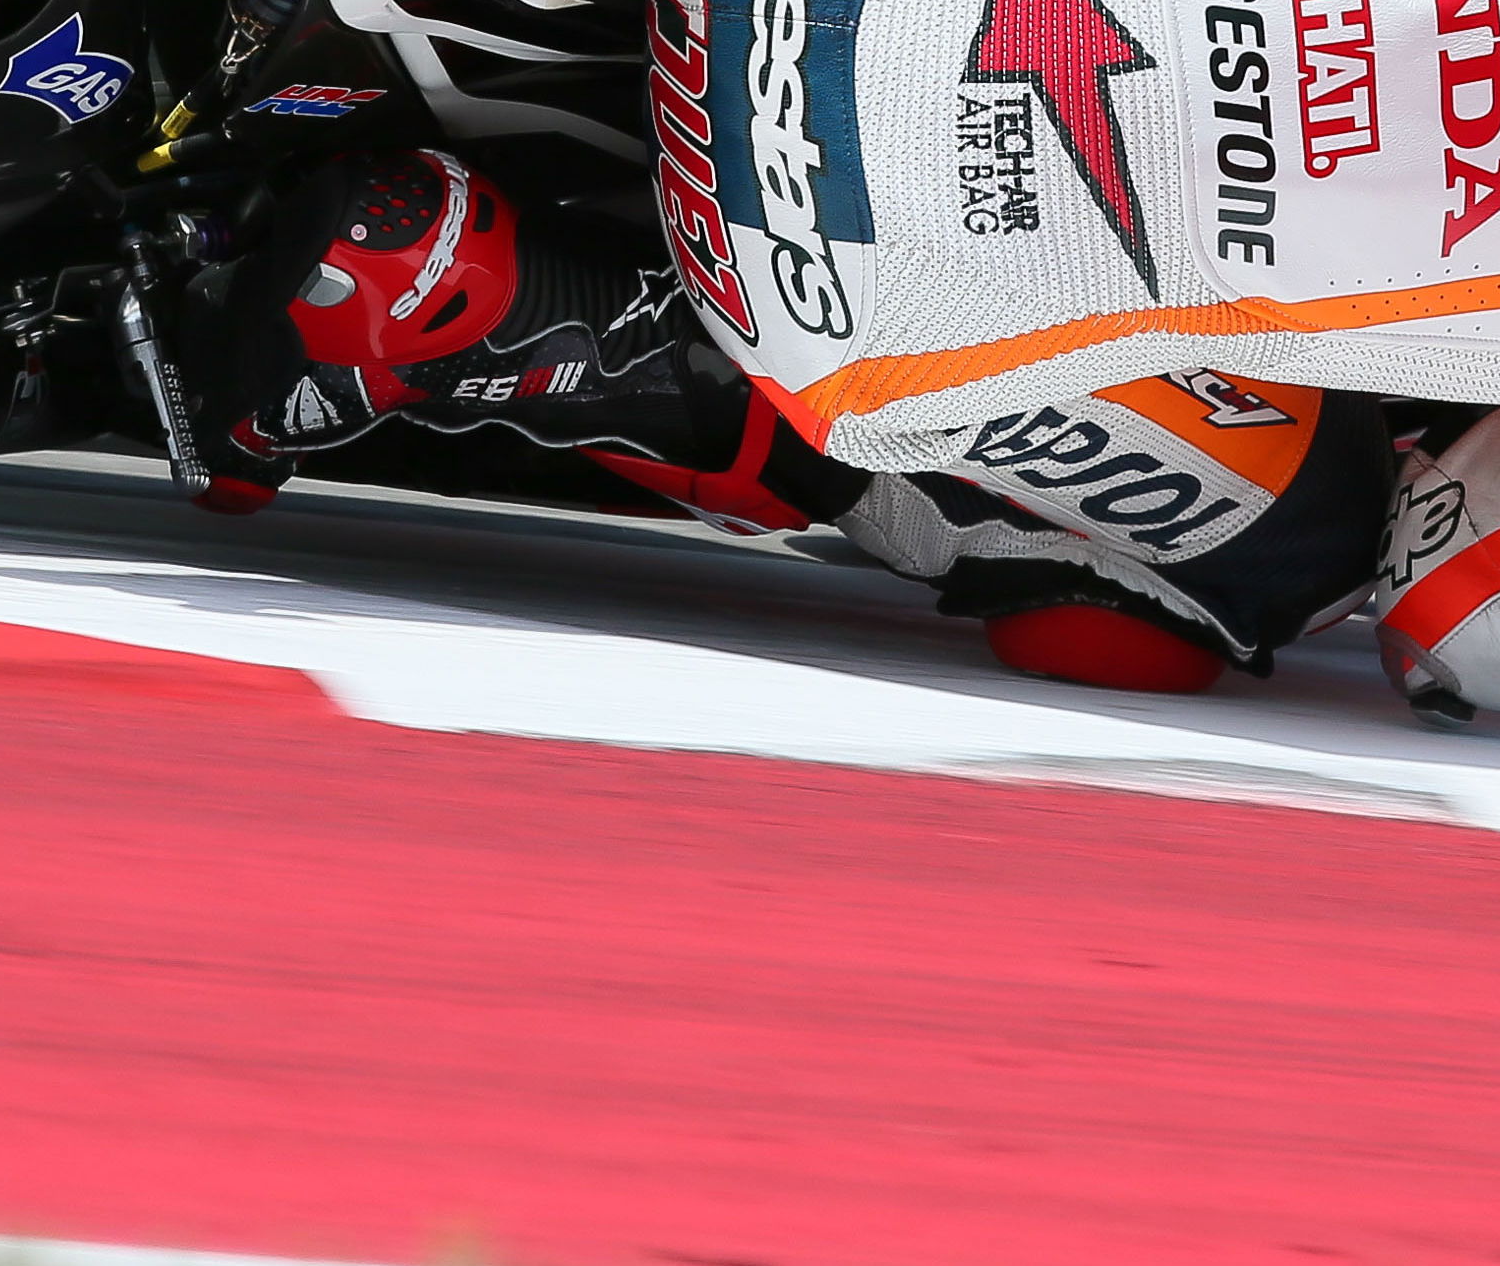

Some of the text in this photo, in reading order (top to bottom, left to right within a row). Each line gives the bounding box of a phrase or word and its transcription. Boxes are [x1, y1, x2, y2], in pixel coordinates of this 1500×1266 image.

[25, 59, 126, 114] GAS
[955, 92, 1000, 236] AIR BAG
